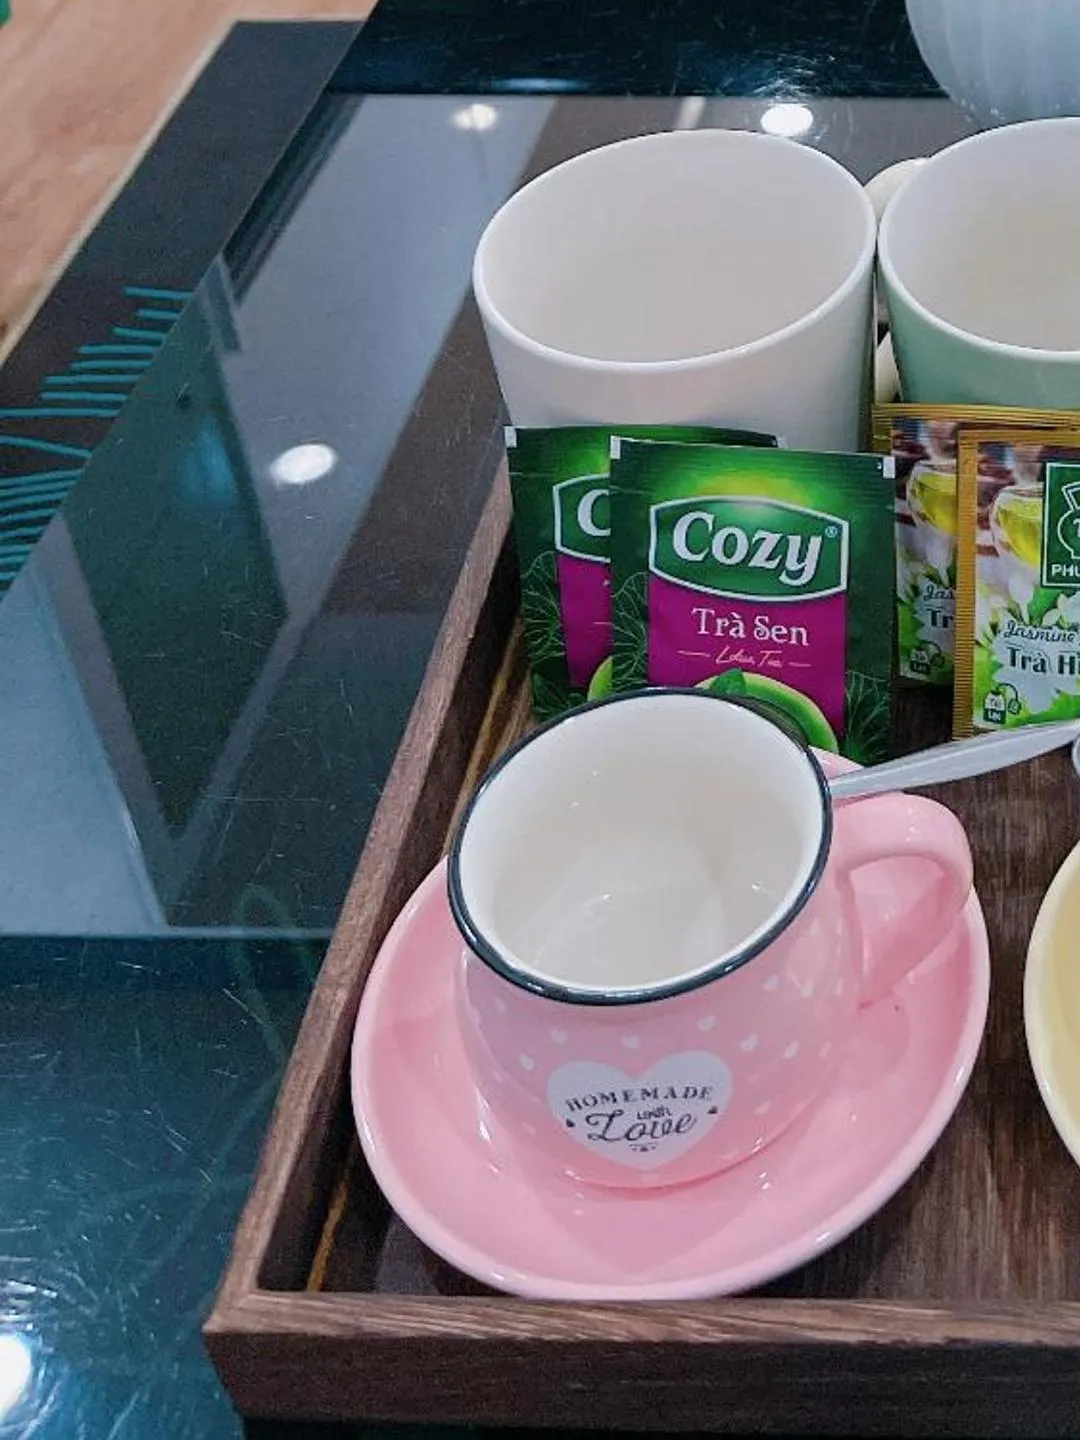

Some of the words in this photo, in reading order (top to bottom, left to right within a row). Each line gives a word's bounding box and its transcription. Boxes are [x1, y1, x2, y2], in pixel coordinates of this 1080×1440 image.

[672, 510, 824, 587] Cozy
[691, 607, 747, 639] Trà
[753, 615, 809, 647] Sen
[1003, 619, 1075, 643] Jasmine
[1006, 646, 1048, 674] Trà
[565, 1085, 714, 1113] HOMEMADE
[585, 1109, 699, 1142] Love
